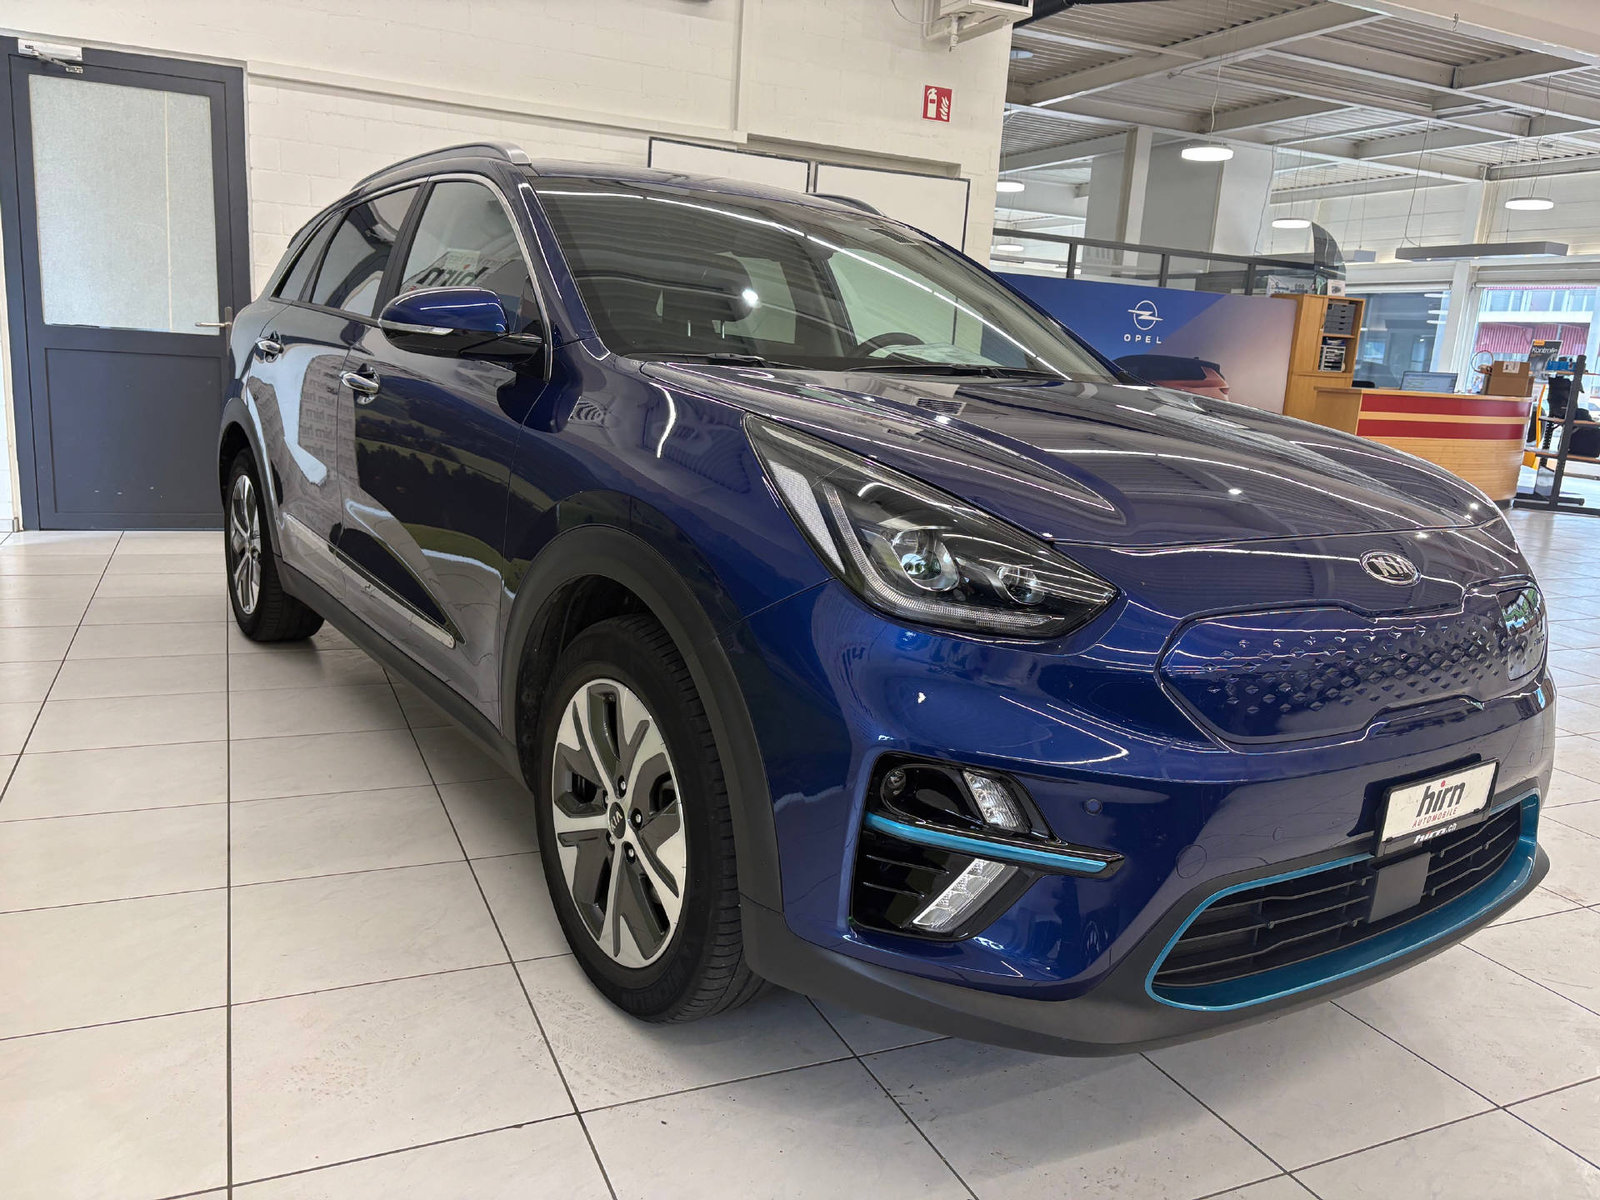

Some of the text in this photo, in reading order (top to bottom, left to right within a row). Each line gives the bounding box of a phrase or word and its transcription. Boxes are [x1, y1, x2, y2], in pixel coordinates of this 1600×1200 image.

[1123, 333, 1162, 344] OPEL
[1416, 780, 1466, 817] hirn
[1412, 807, 1458, 828] AUTOMOBILE
